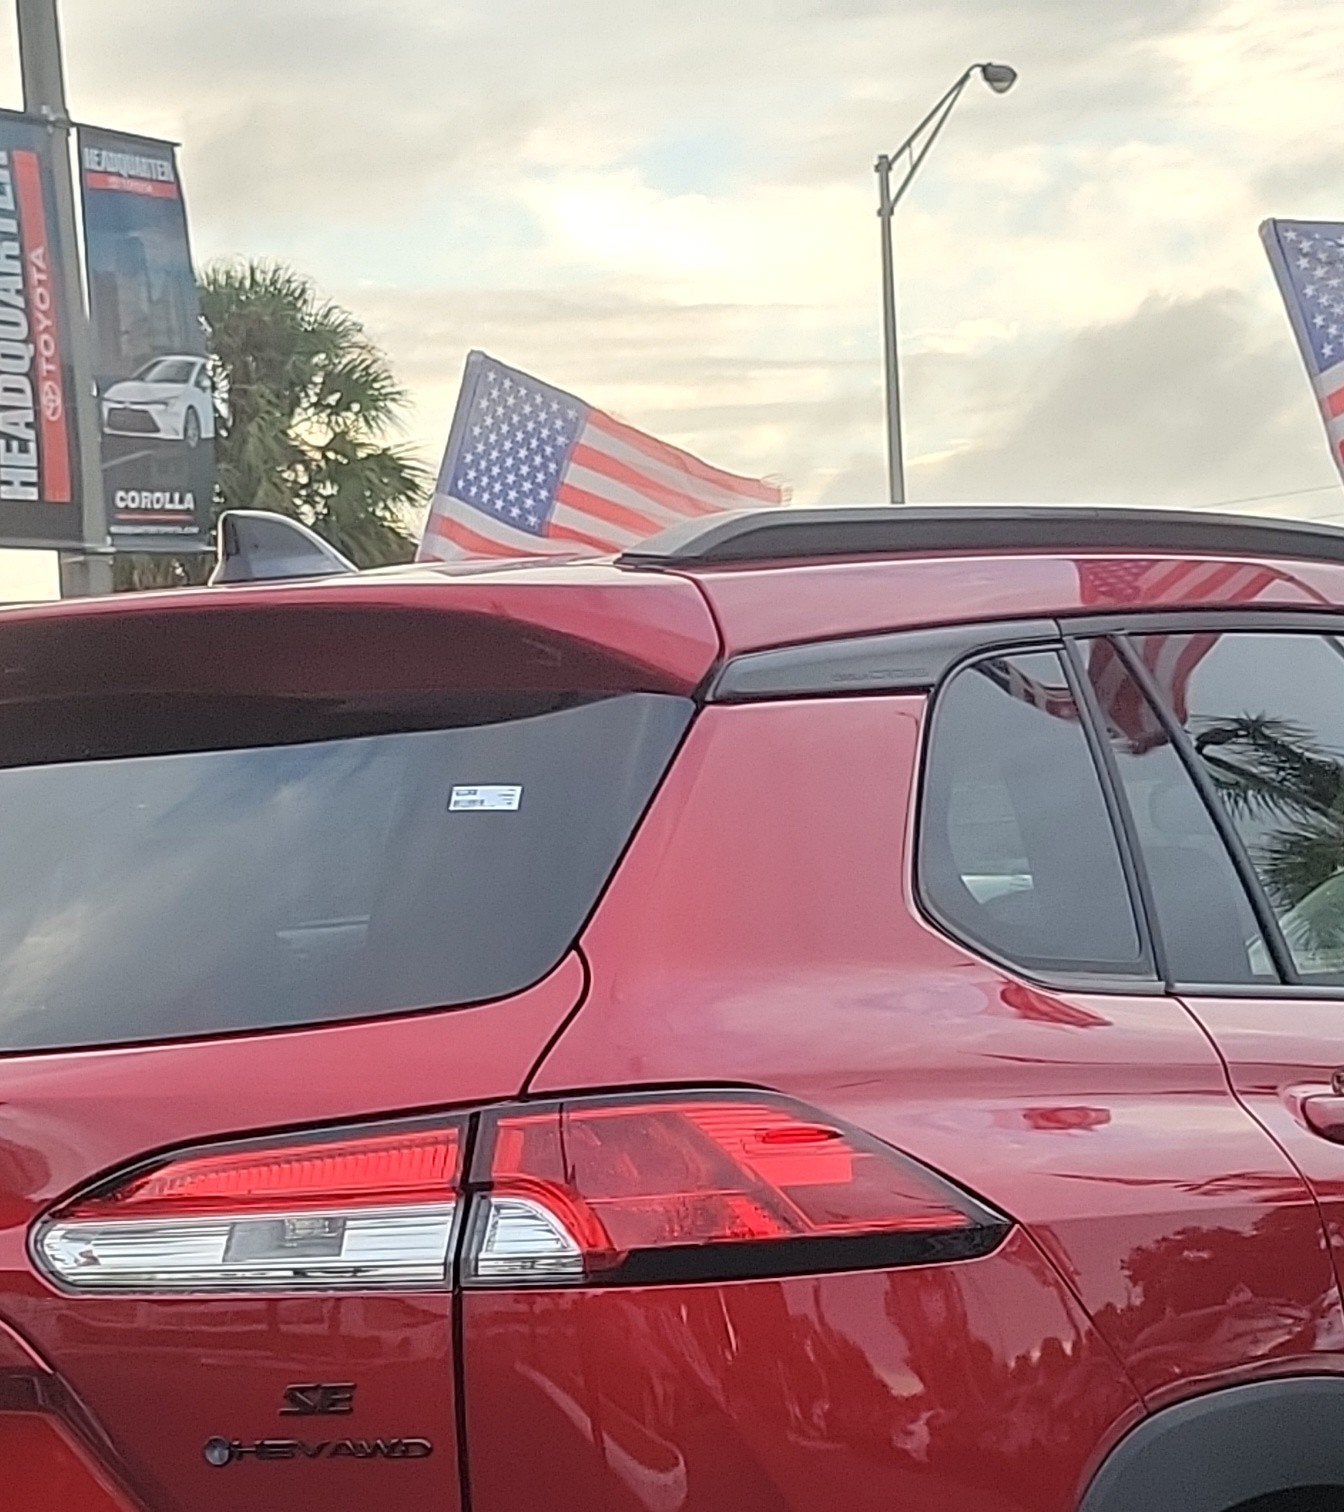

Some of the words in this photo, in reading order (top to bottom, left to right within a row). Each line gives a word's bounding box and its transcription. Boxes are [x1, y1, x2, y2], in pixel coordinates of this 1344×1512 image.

[83, 147, 175, 183] HEADQUARTER
[30, 246, 57, 379] TOYOTA
[115, 489, 195, 512] COROLLA
[278, 1381, 357, 1416] SE
